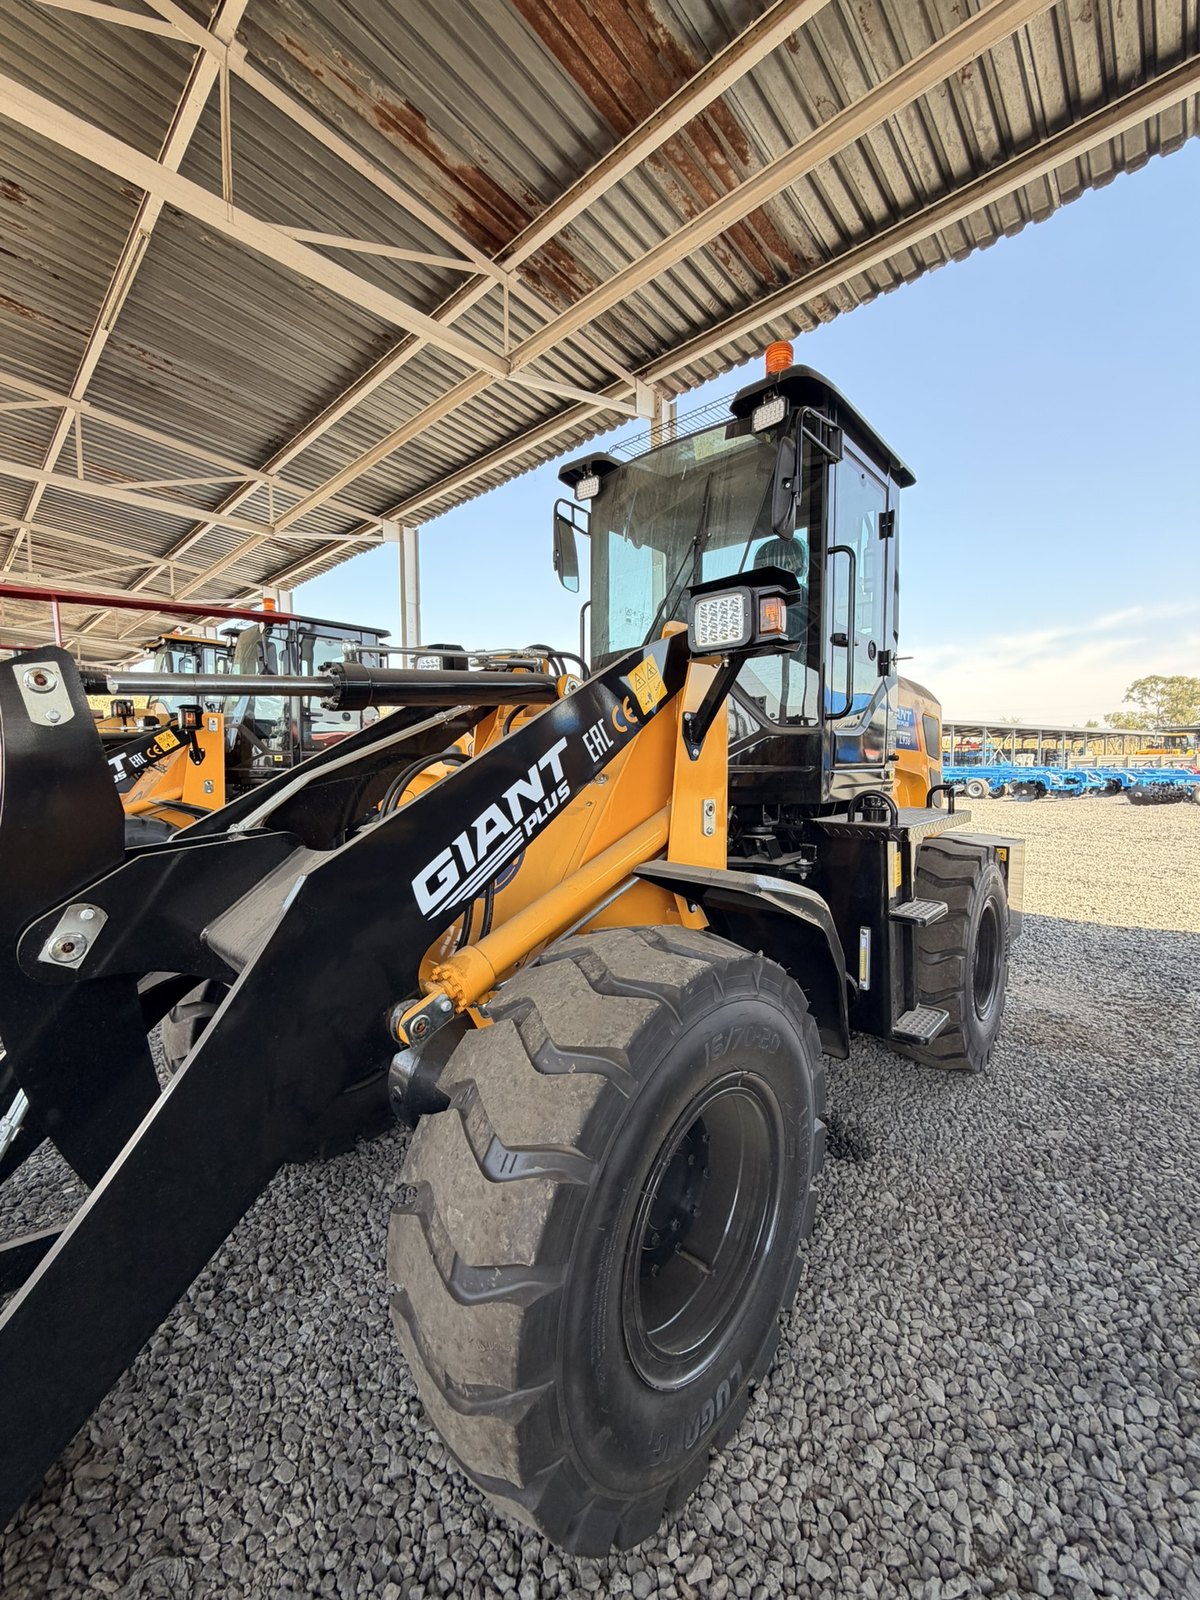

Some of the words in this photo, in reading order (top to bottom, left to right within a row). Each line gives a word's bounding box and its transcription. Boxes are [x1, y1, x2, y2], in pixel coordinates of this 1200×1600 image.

[896, 708, 912, 721] ANT
[411, 736, 568, 916] GIANT
[523, 780, 570, 837] PLUS
